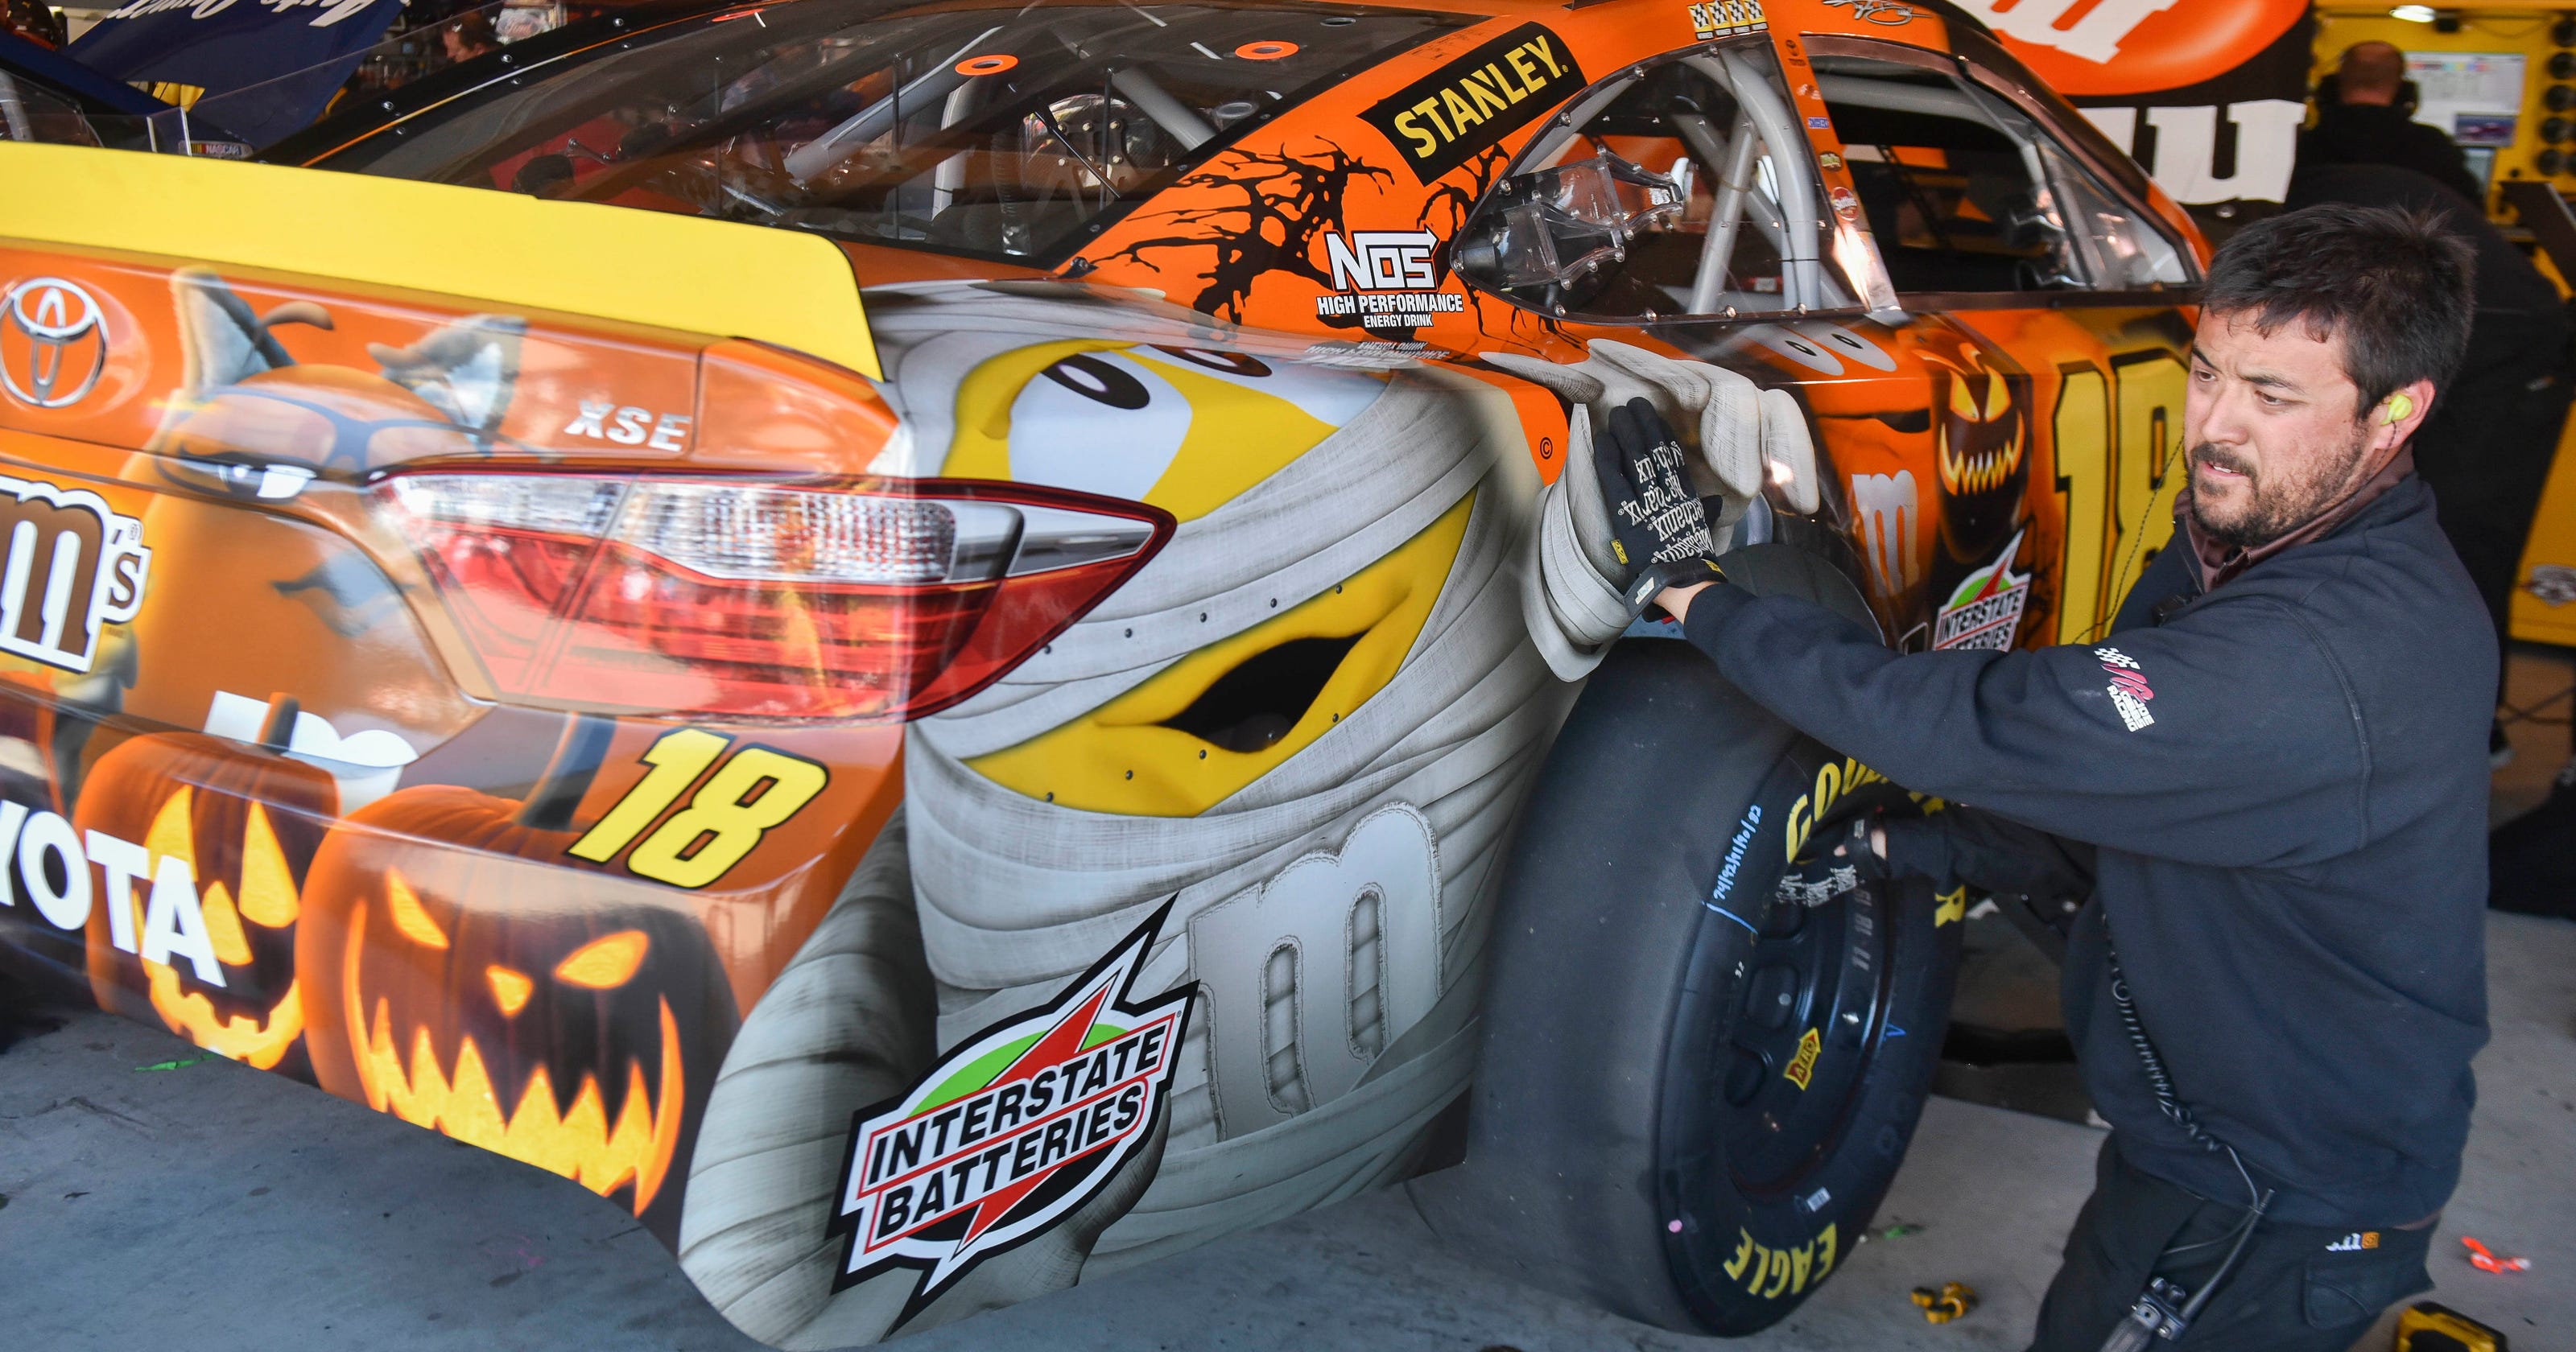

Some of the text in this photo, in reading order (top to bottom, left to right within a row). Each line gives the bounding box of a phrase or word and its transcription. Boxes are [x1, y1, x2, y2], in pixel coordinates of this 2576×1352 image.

[1394, 35, 1563, 159] STANLEY
[1325, 229, 1438, 291] NOS
[1316, 294, 1464, 315] HIGH PERFORMANCE
[1364, 314, 1434, 328] ENERGY DRINK
[564, 400, 692, 453] XSE
[1935, 587, 2022, 643] INTERSTATE
[2107, 685, 2140, 732] RACING
[2132, 699, 2155, 726] JOE
[562, 726, 831, 888] 18
[868, 1024, 1167, 1186] INTERSTATE
[876, 1080, 1146, 1241] BATTERIES
[1723, 1222, 1837, 1299] EAGLE
